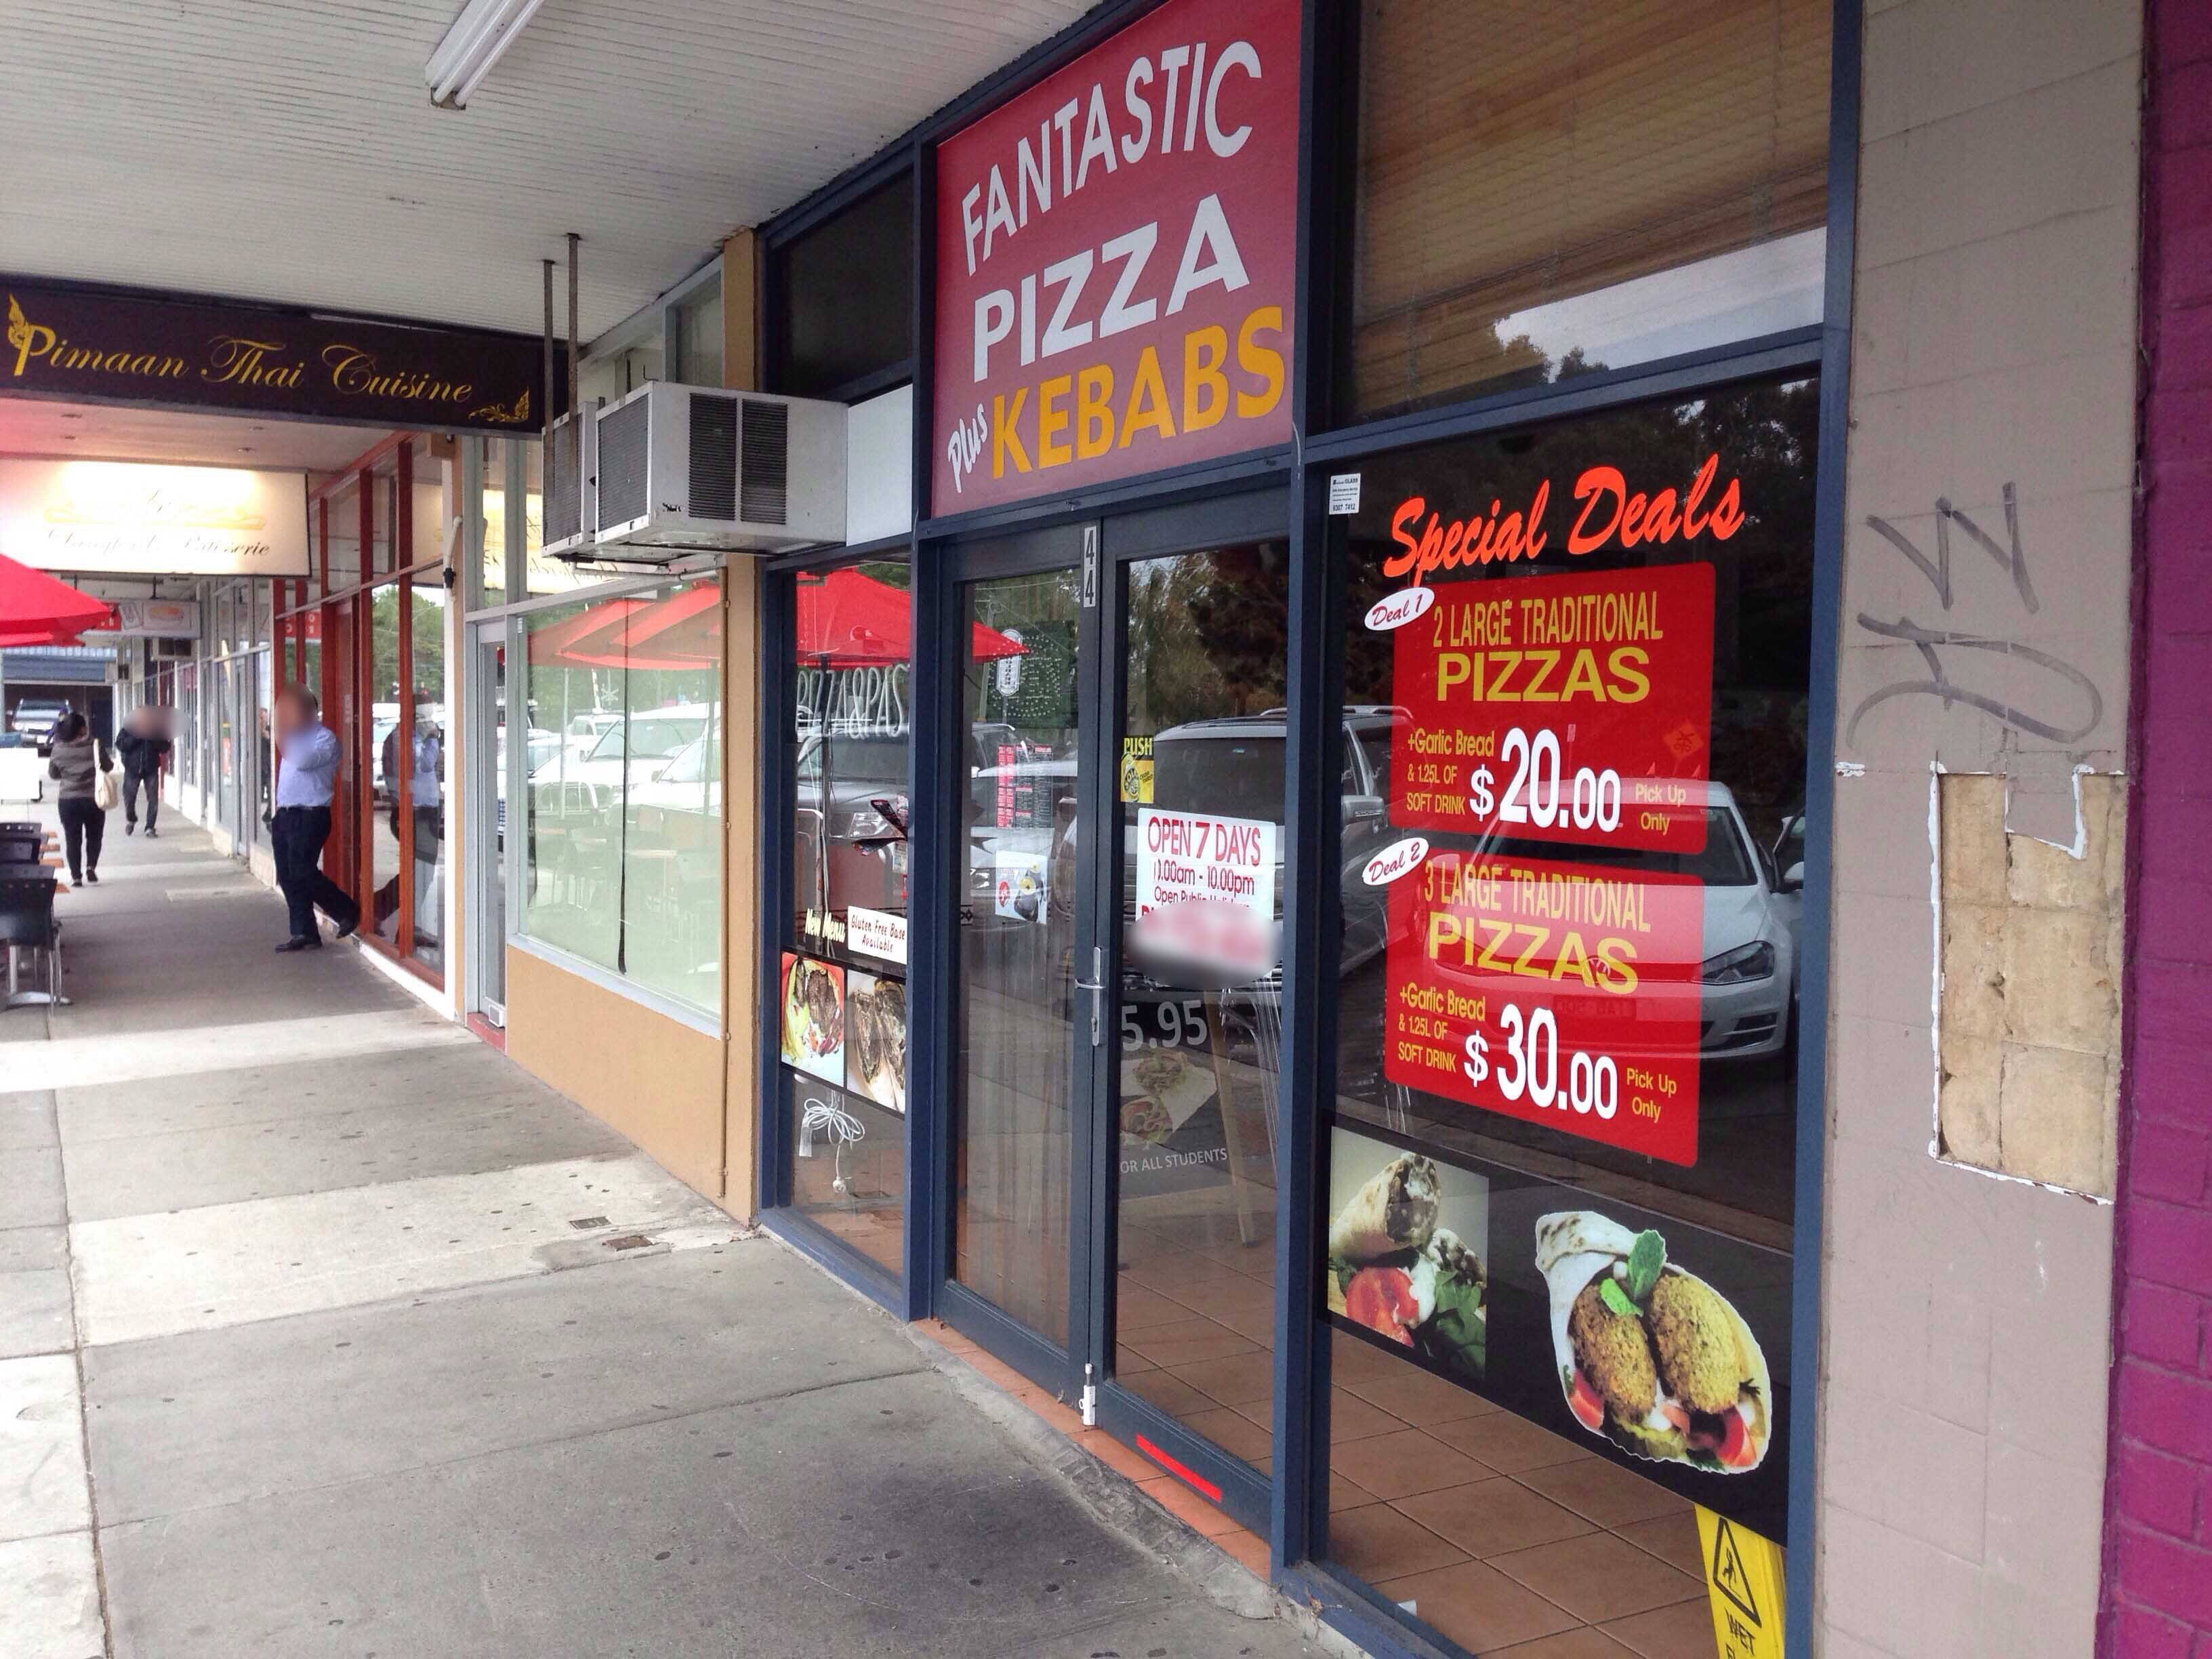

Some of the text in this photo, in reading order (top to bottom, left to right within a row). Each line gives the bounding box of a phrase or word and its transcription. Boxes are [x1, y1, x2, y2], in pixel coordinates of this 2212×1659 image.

[962, 41, 1262, 276] FANTASTIC
[974, 193, 1250, 382] PIZZA
[14, 323, 473, 403] Pimaan Thai Cuisine
[948, 306, 1285, 493] plus KEBABS
[1384, 479, 1550, 588] Special
[1568, 453, 1745, 554] Deals
[1372, 594, 1423, 627] Deal 1
[1433, 591, 1663, 647] 2 LARGE TRADITIONAL
[1437, 647, 1650, 703] PIZZAS
[1124, 737, 1153, 756] PUSH
[1408, 727, 1494, 757] +Garlic Bread
[1408, 764, 1414, 782] &
[1443, 765, 1457, 785] OF
[1407, 792, 1465, 816] SOFT DRINK
[1635, 783, 1686, 807] Pick Up
[1641, 813, 1670, 836] Only
[1148, 817, 1261, 867] OPEN 7 DAYS
[1369, 842, 1420, 883] Deal 2
[1154, 885, 1178, 905] Open
[1208, 865, 1254, 897] 10.00pm
[1425, 861, 1652, 933] 3 LARGE TRADITIONAL
[805, 908, 846, 943] New Menu
[851, 914, 905, 940] Gluten Free Base
[862, 934, 893, 953] Available
[1429, 911, 1639, 995] PIZZAS
[1399, 982, 1486, 1022] +Garlic Bread
[1399, 1015, 1405, 1031] &
[1434, 1021, 1448, 1040] OF
[1398, 1041, 1456, 1073] SOFT DRINK
[1626, 1066, 1677, 1098] Pick Up
[1632, 1097, 1661, 1123] Only
[1141, 1156, 1163, 1170] ALL
[1166, 1148, 1228, 1168] STUDENTS
[1724, 1607, 1756, 1656] WET
